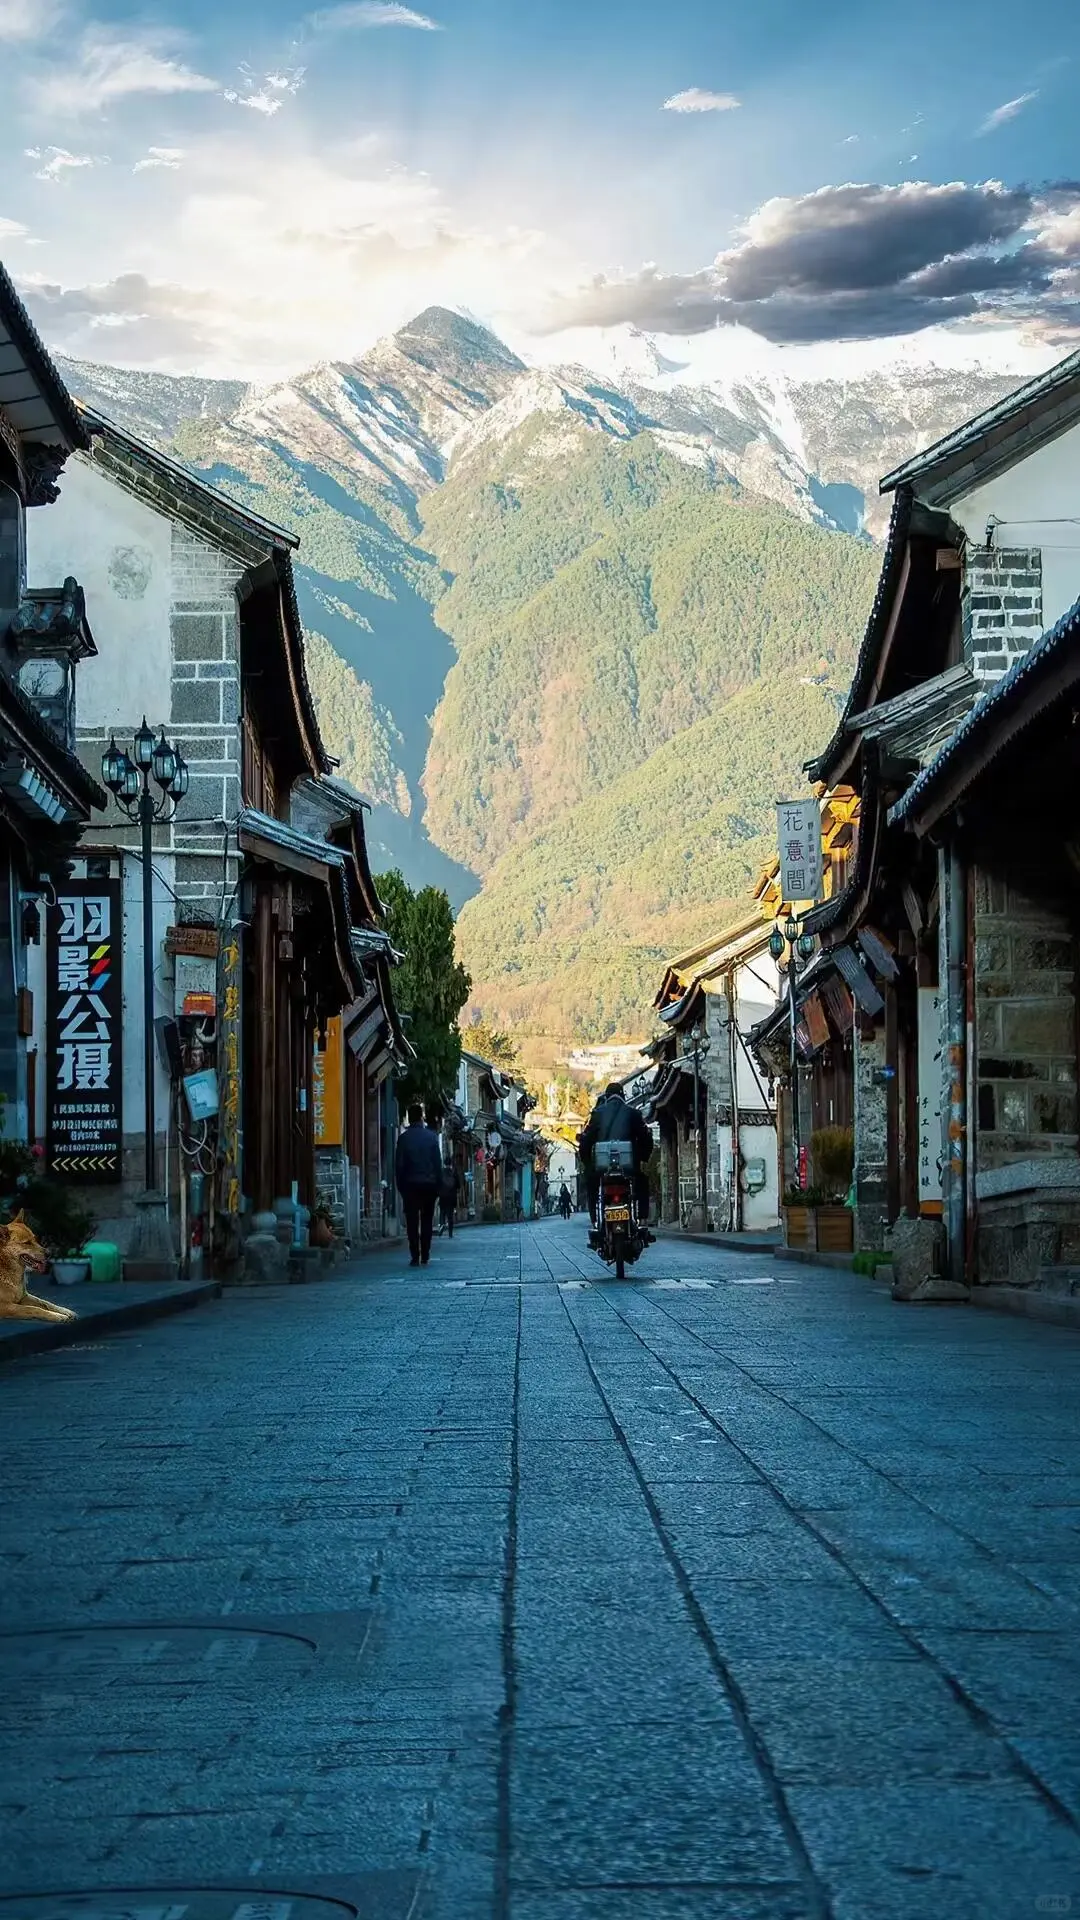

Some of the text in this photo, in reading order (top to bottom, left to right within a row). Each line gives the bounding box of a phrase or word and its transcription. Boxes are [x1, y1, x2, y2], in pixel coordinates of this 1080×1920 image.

[783, 808, 805, 892] 花意間
[57, 896, 112, 1090] 羽影公摄
